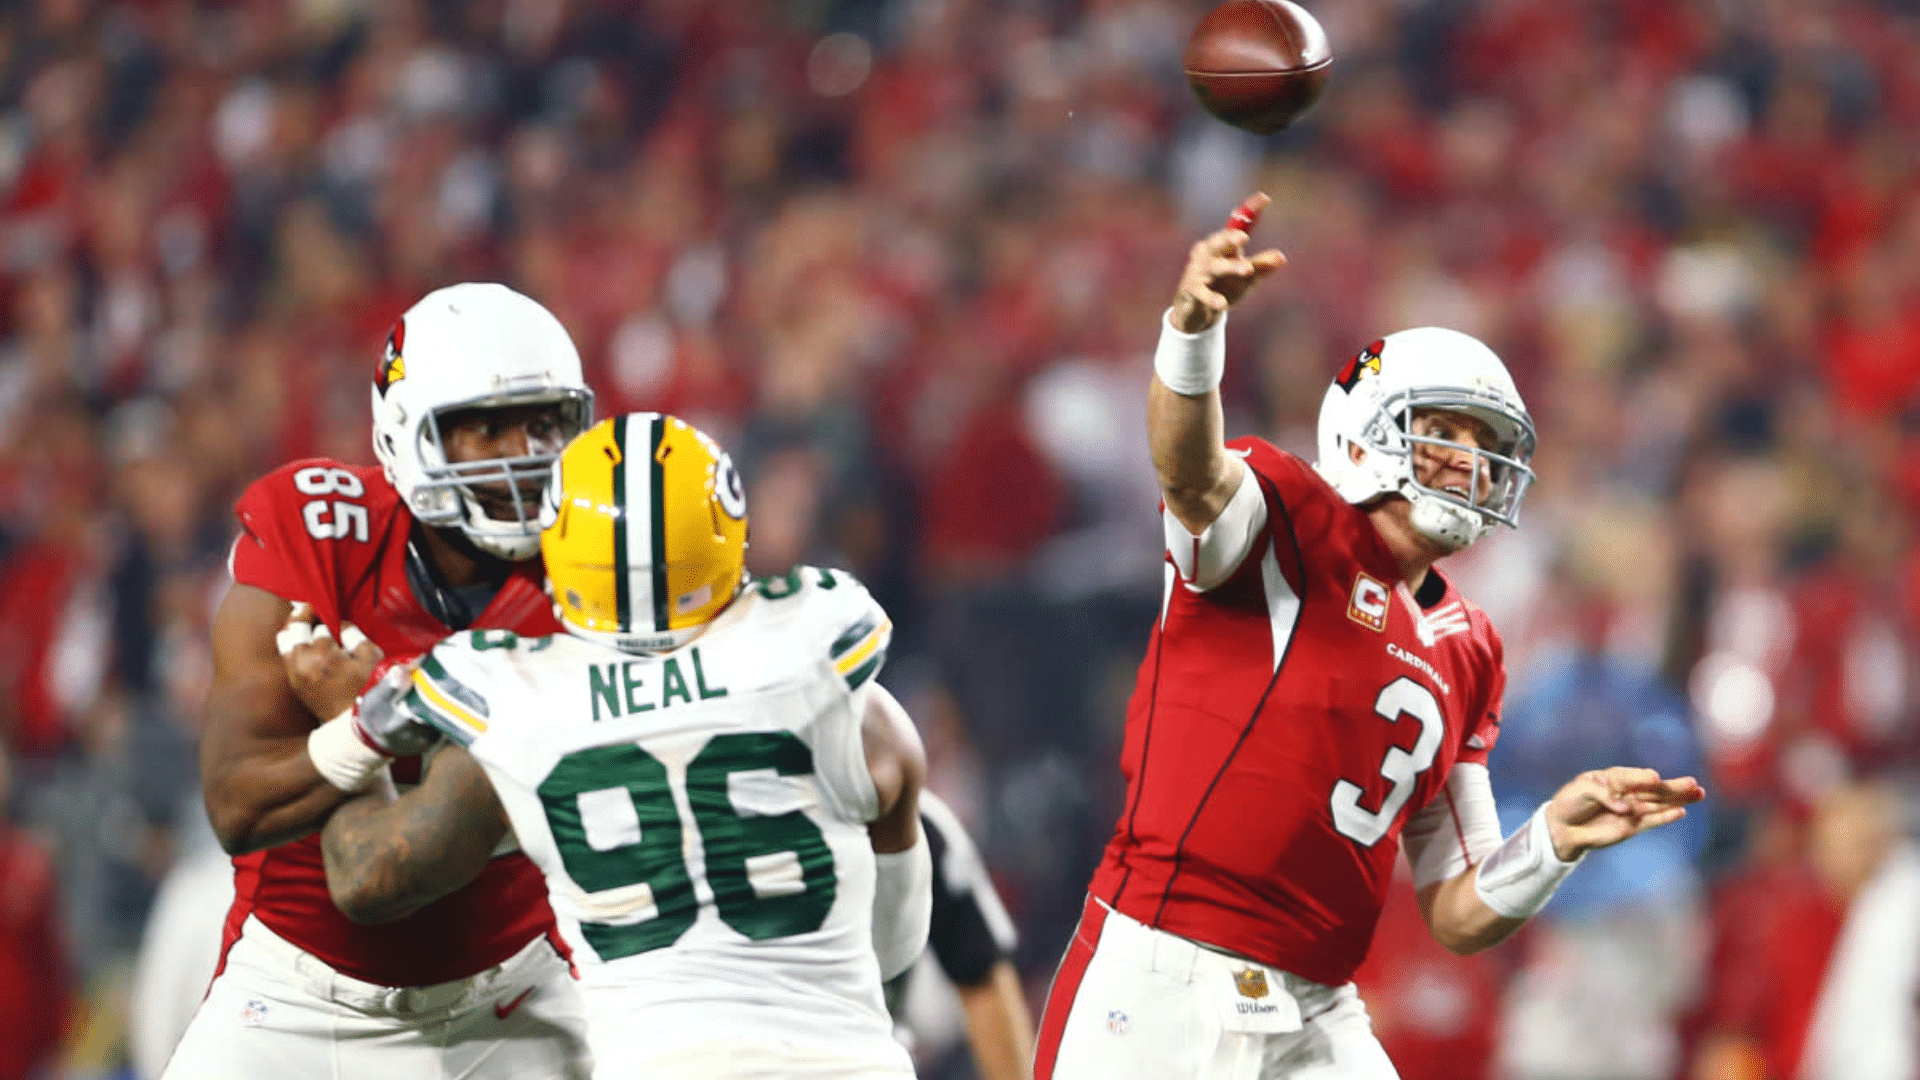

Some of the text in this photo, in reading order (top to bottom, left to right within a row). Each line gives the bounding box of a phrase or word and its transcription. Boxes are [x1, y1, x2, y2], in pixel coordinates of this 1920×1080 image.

[293, 466, 371, 543] 85
[1354, 578, 1387, 618] C
[588, 647, 729, 722] NEAL
[1329, 675, 1445, 847] 3
[536, 728, 838, 962] 96
[1235, 1001, 1279, 1014] Wilson
